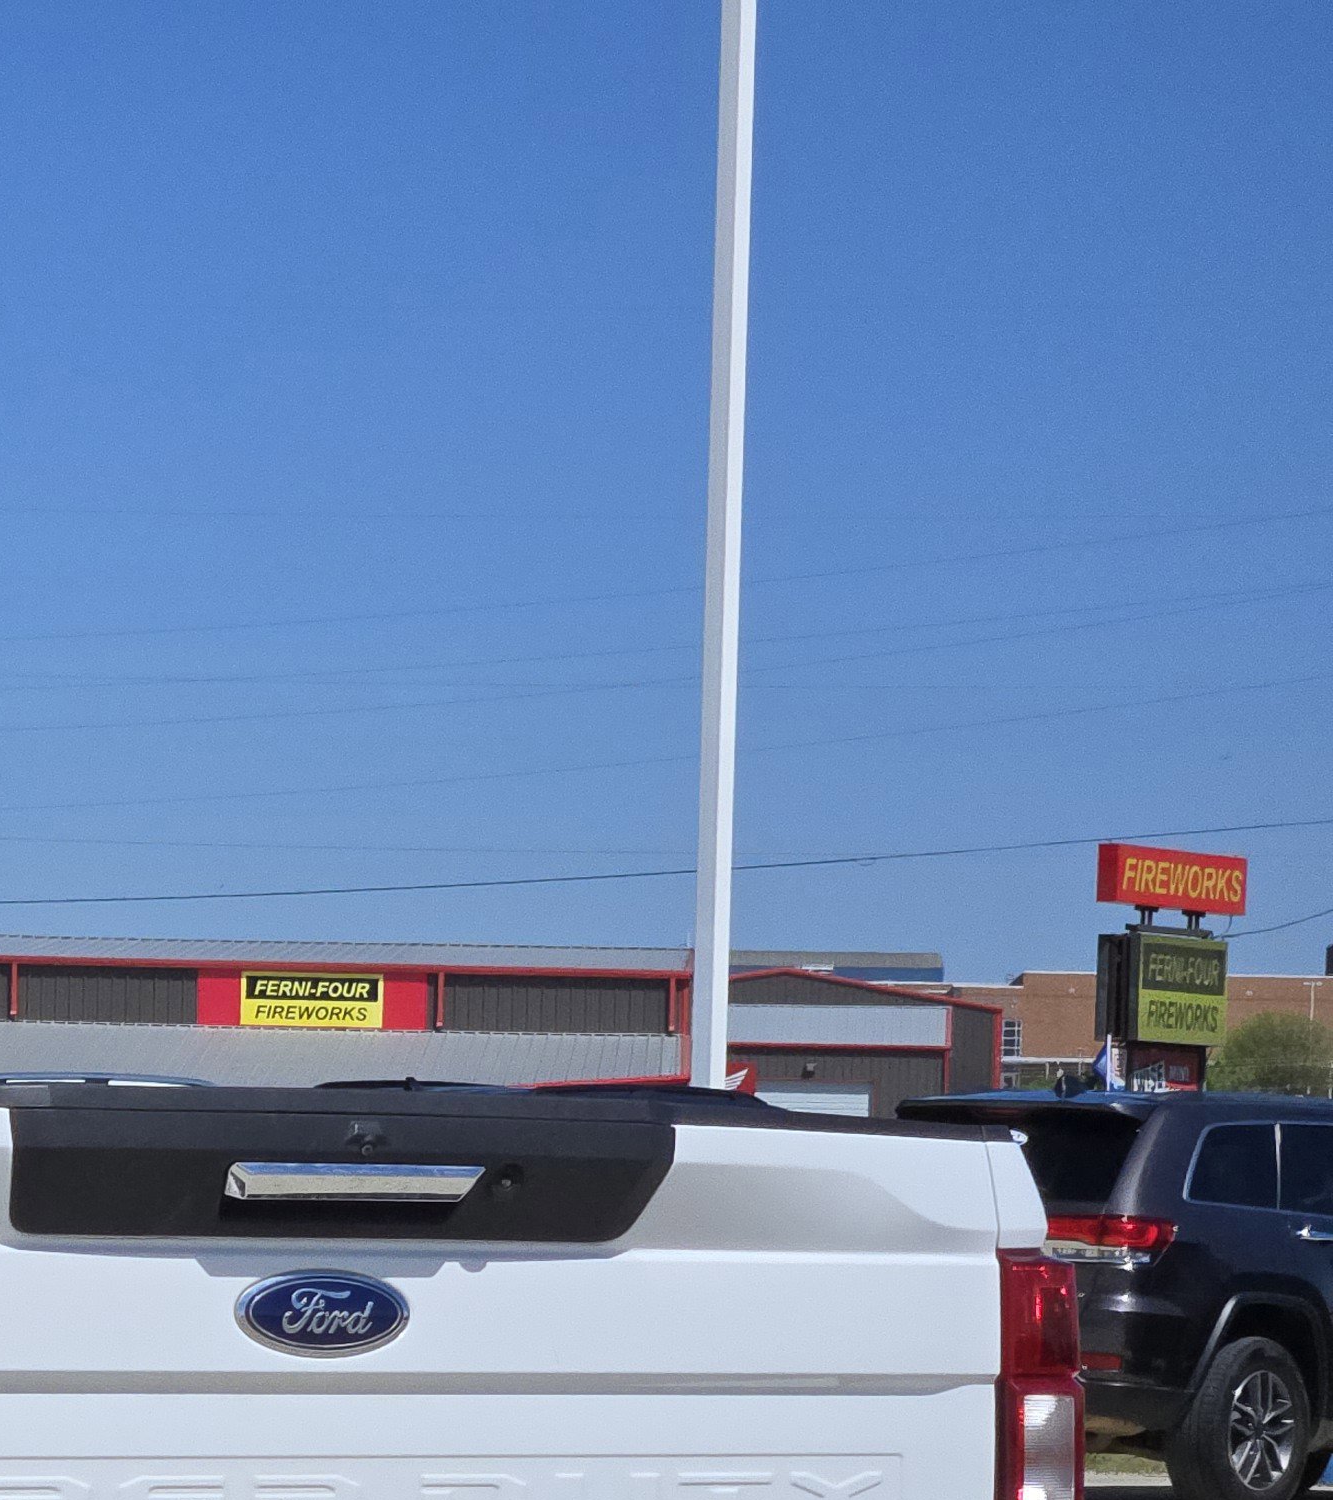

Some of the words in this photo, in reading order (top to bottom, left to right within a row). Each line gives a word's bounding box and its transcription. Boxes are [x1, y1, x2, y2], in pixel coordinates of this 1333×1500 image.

[1122, 857, 1243, 903] FIREWORKS
[254, 979, 371, 999] FERNI-FOUR
[254, 1004, 368, 1022] FIREWORKS
[1146, 999, 1219, 1033] FIREWORKS
[282, 1288, 374, 1334] Ford
